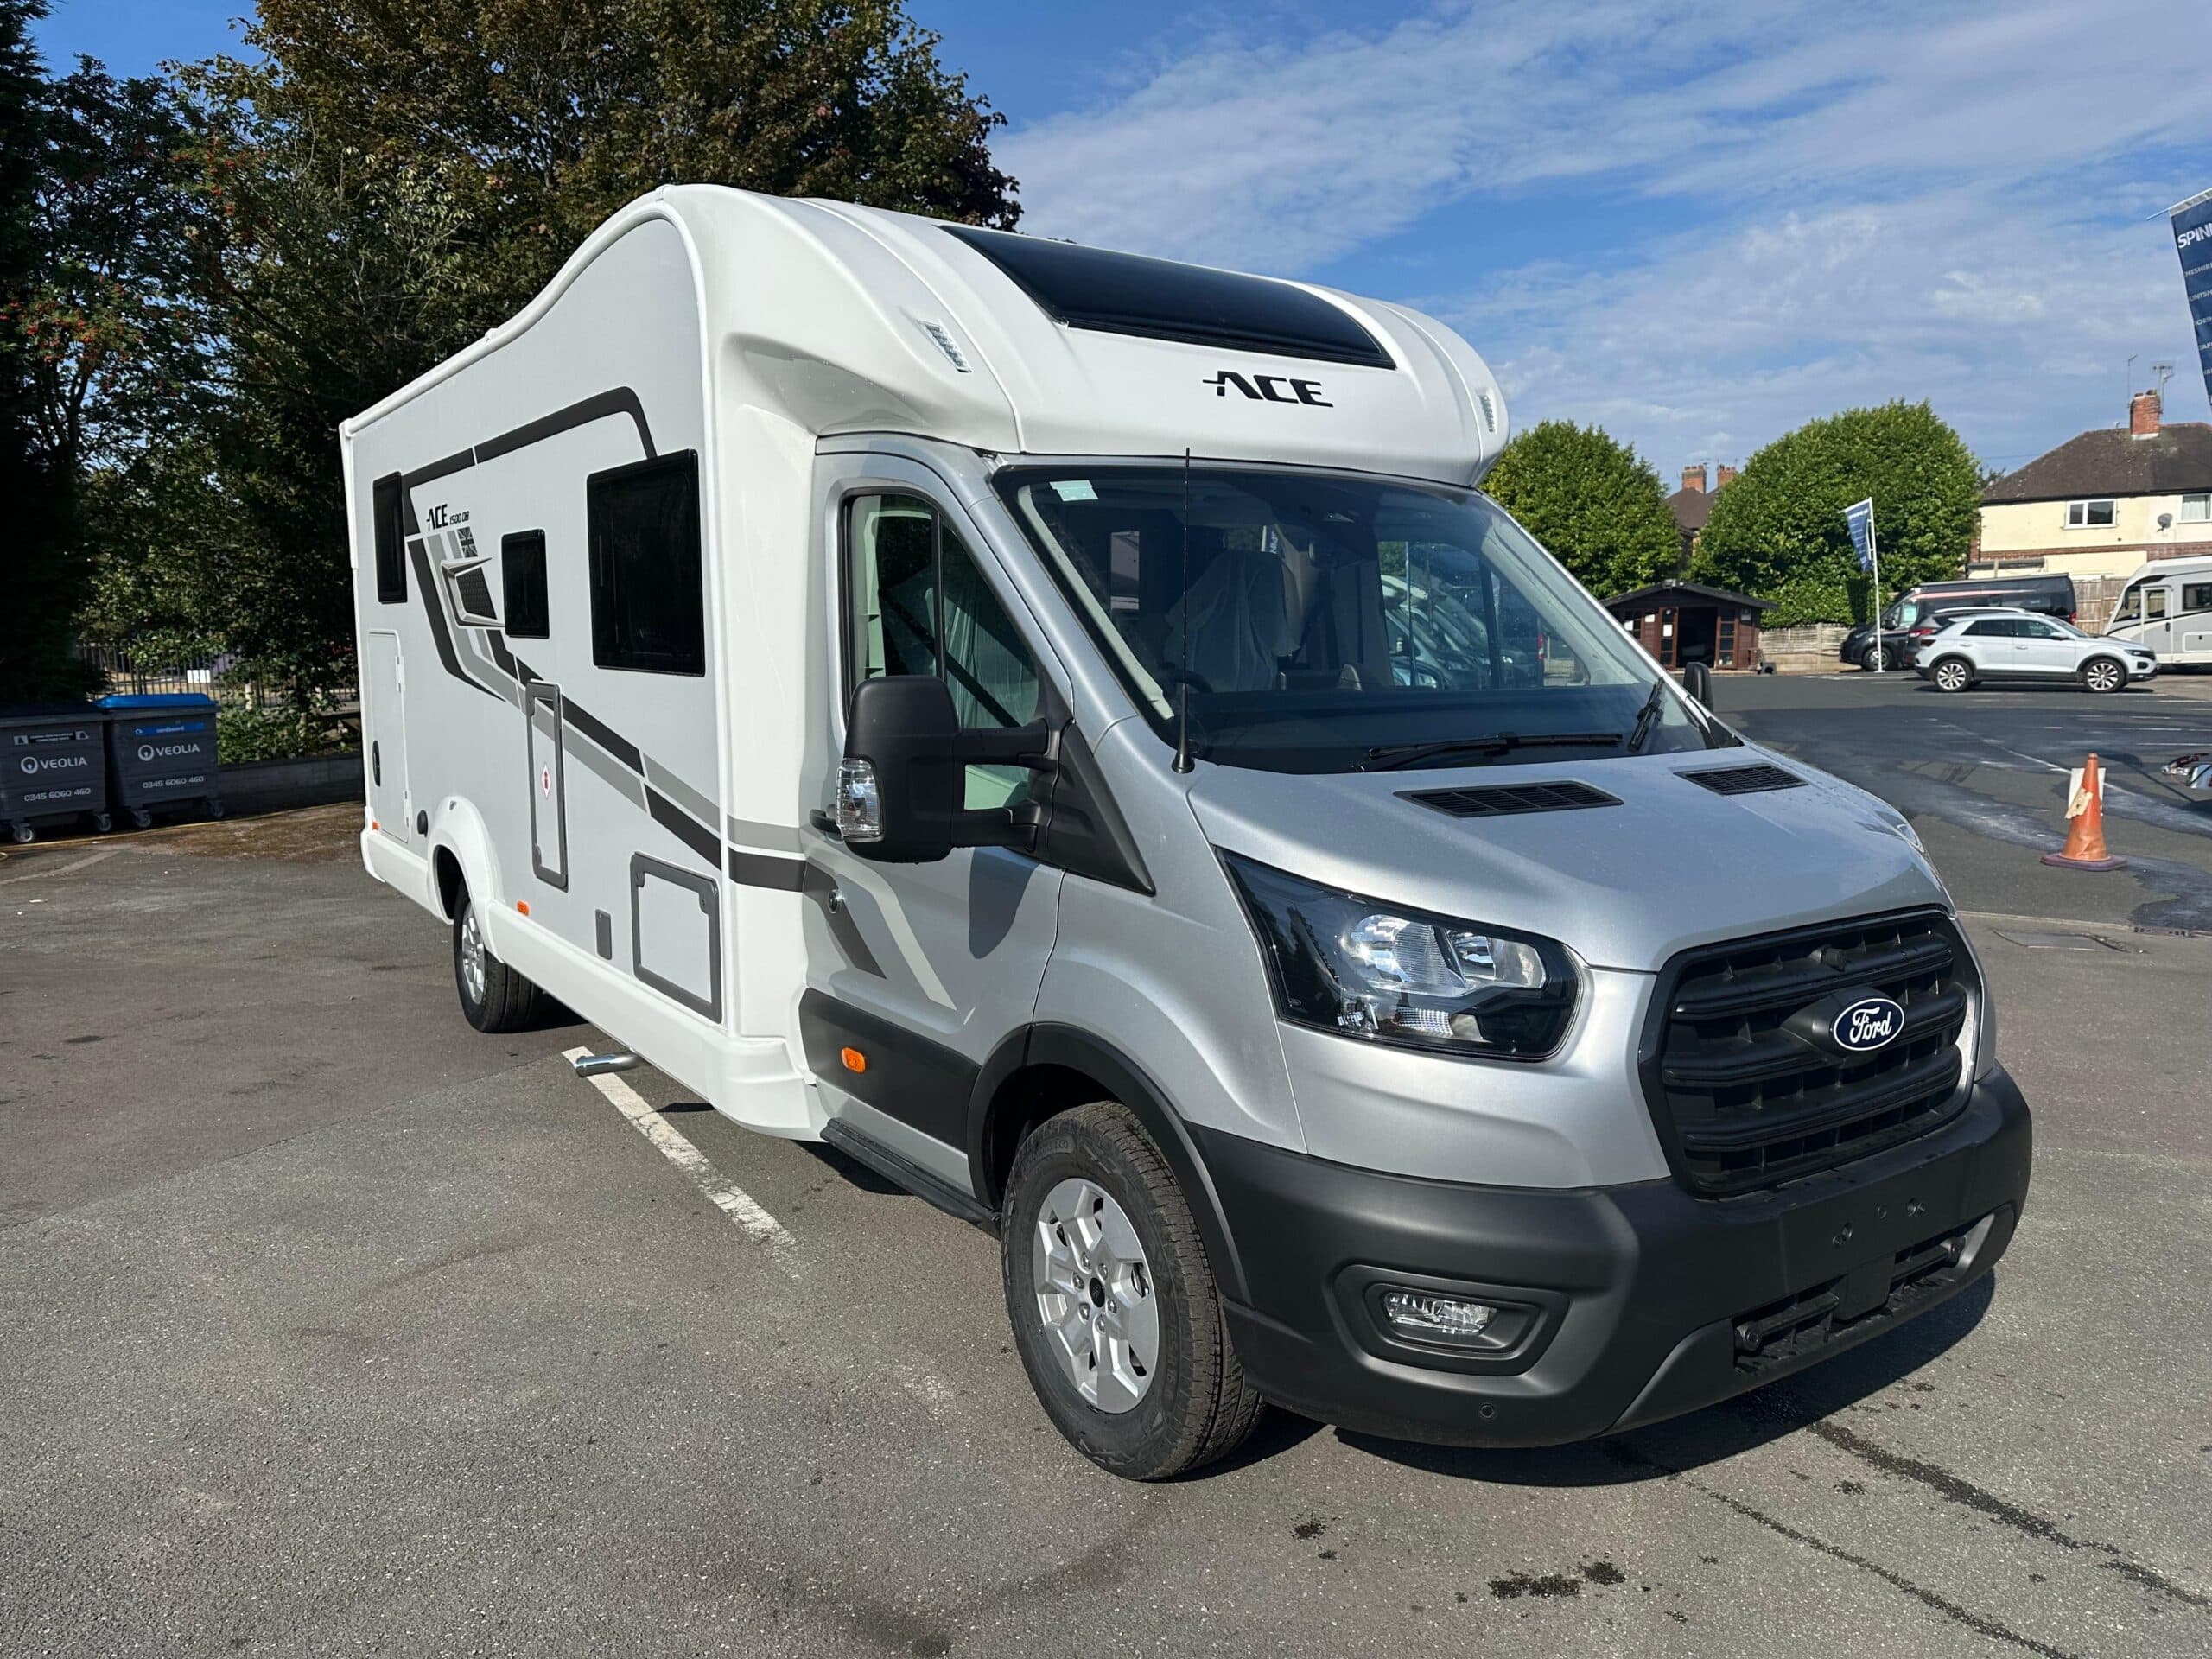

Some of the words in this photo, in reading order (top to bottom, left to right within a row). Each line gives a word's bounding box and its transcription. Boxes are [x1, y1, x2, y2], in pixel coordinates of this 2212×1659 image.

[1203, 371, 1333, 407] ACE
[426, 503, 448, 531] ACE
[156, 744, 200, 756] VEOLIA
[40, 757, 87, 769] VEOLIA
[165, 778, 187, 786] 6060
[24, 792, 47, 802] 0345
[48, 790, 72, 799] 6060
[74, 787, 91, 796] 460
[1849, 1007, 1892, 1043] Ford
